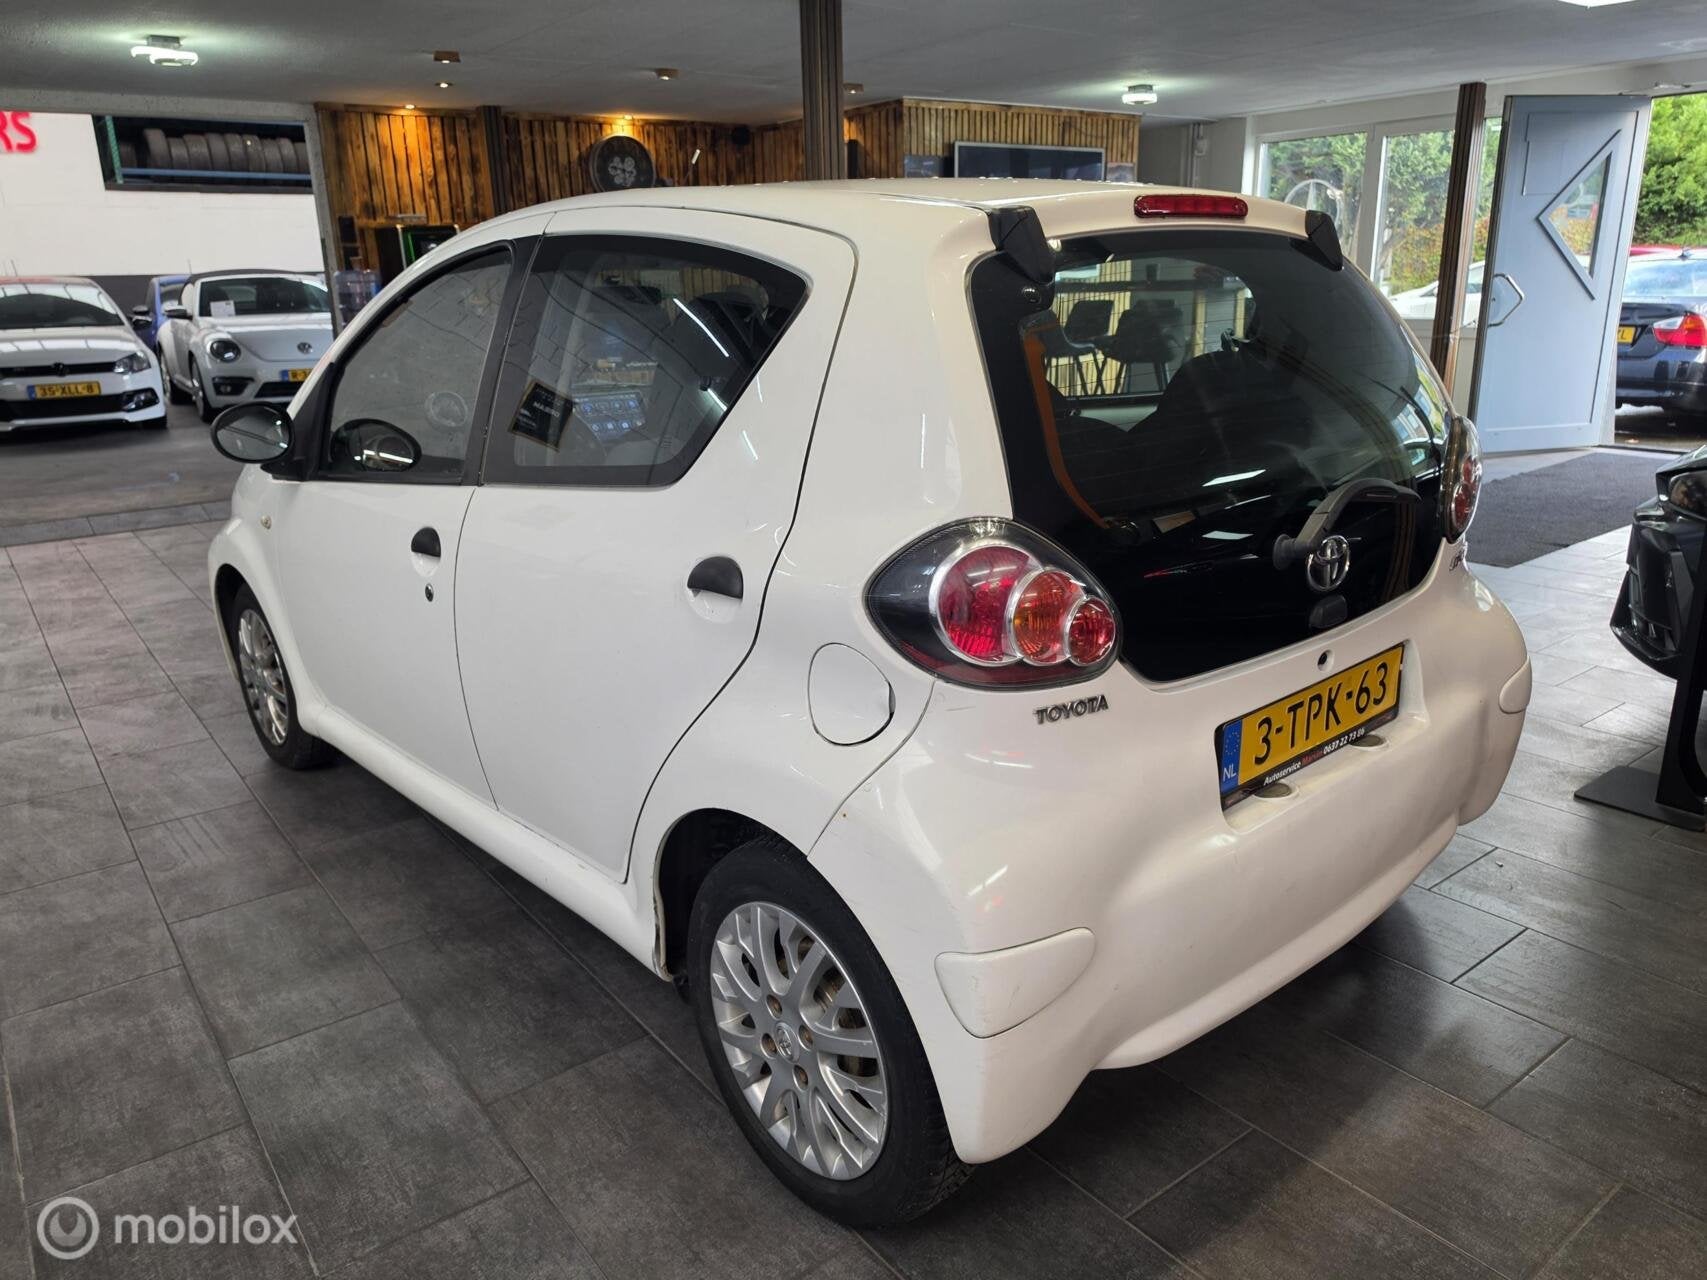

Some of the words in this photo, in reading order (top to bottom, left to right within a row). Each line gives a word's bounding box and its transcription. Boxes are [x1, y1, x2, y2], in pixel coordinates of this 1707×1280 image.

[1034, 694, 1109, 725] TOYOTA
[1254, 662, 1389, 765] 3-TPK-63
[1223, 764, 1237, 782] NL
[1263, 761, 1301, 786] Autoservice
